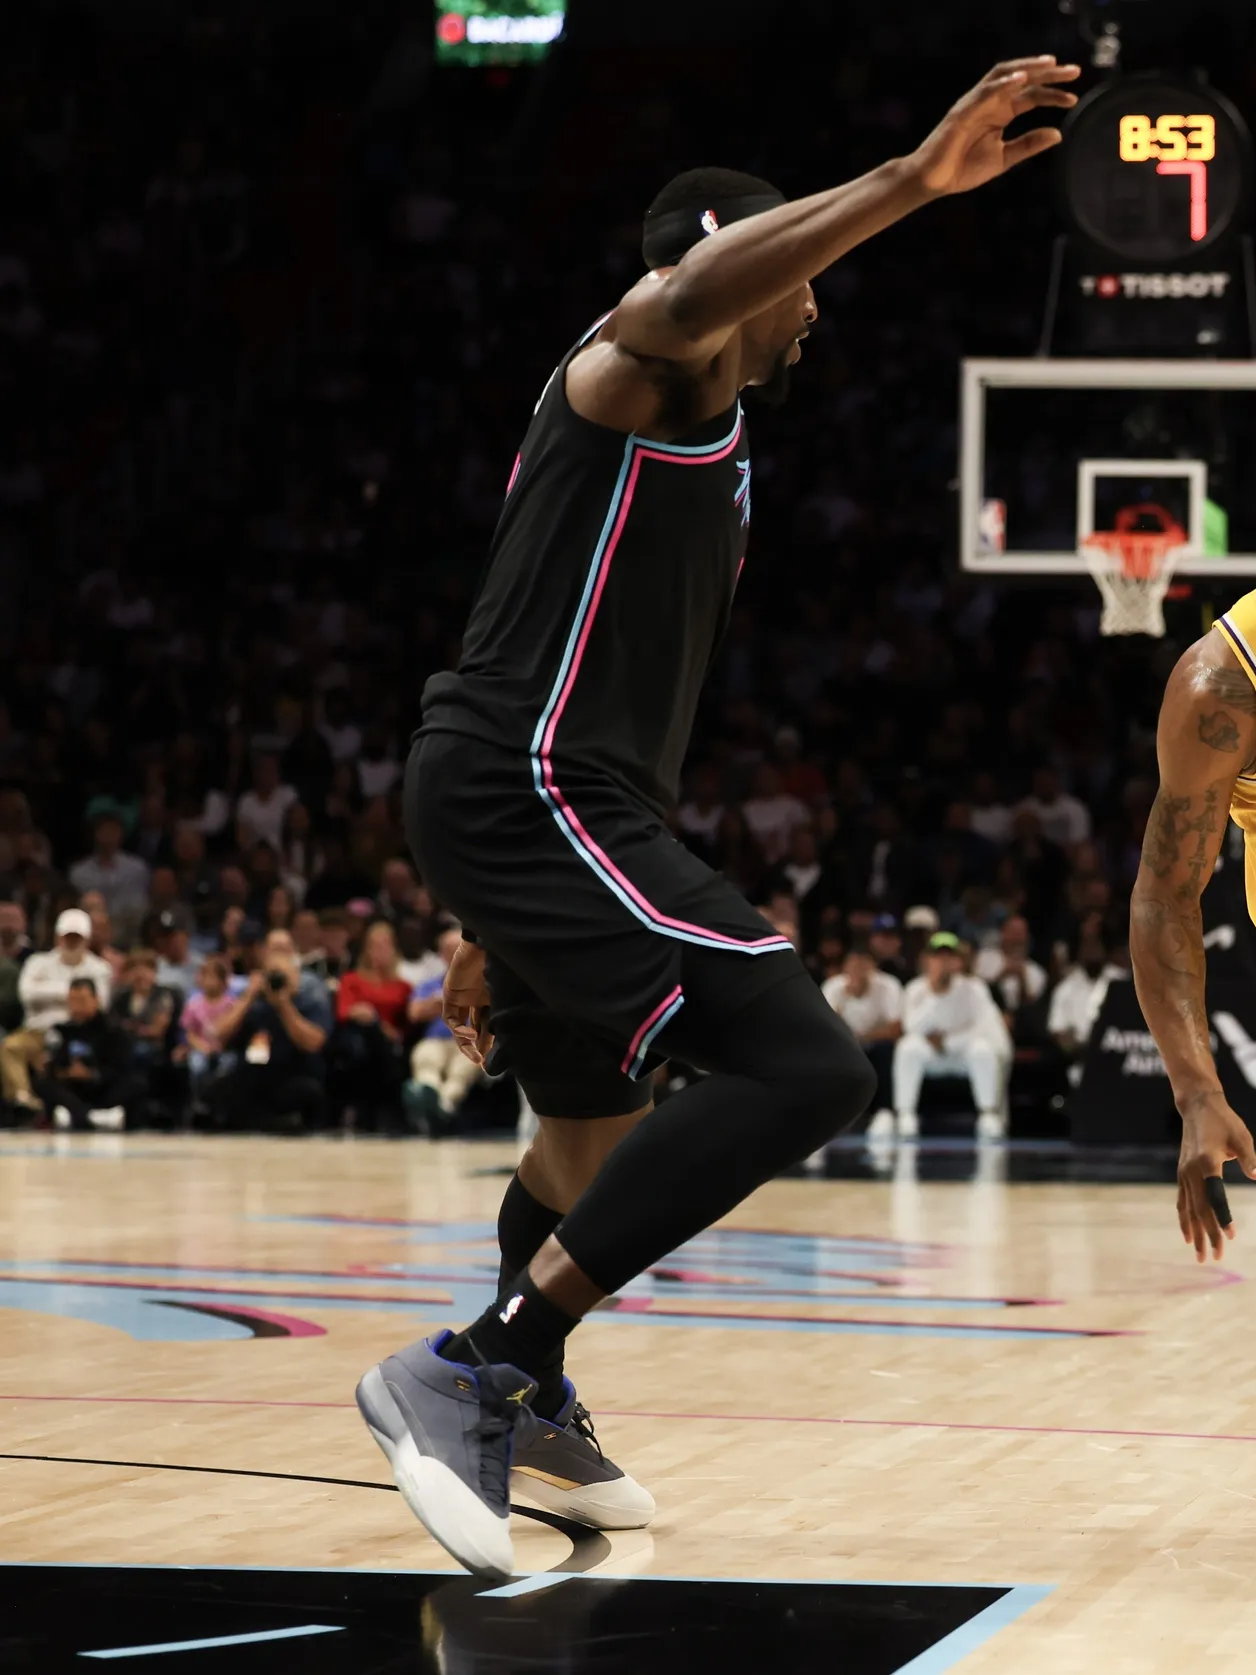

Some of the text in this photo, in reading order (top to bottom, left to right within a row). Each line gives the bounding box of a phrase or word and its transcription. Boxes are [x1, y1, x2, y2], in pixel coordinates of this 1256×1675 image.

[1119, 115, 1215, 162] 8:53
[1156, 161, 1207, 241] 7
[1121, 272, 1230, 298] TISSOT
